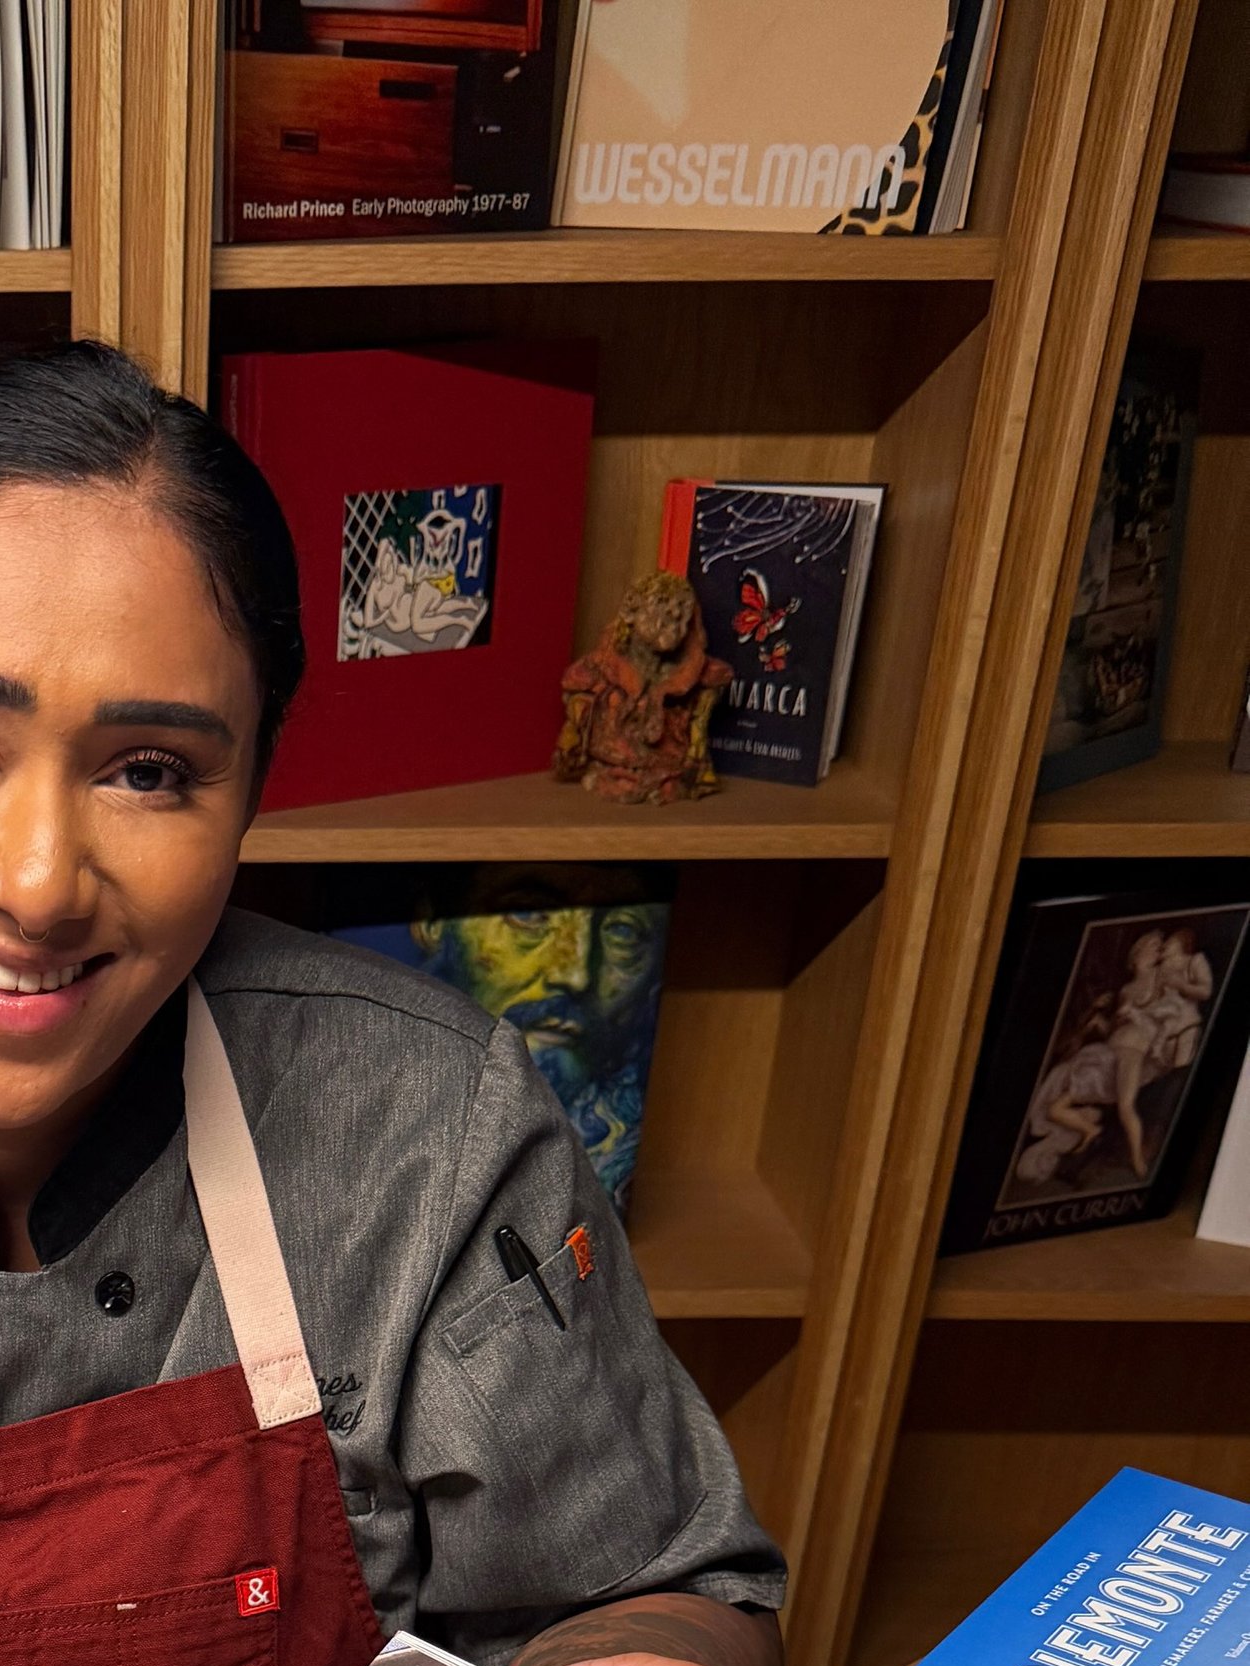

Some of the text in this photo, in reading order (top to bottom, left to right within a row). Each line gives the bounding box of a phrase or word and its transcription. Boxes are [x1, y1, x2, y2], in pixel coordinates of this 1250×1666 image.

[243, 193, 530, 219] Richard Prince Early Photography 1977-87
[729, 679, 808, 717] NARCA
[981, 1192, 1149, 1246] JOHN CURRIN
[316, 1373, 364, 1396] nes
[324, 1400, 366, 1436] hef
[1030, 1551, 1102, 1617] ON THE ROAD IN
[1200, 1588, 1241, 1626] FARMERS
